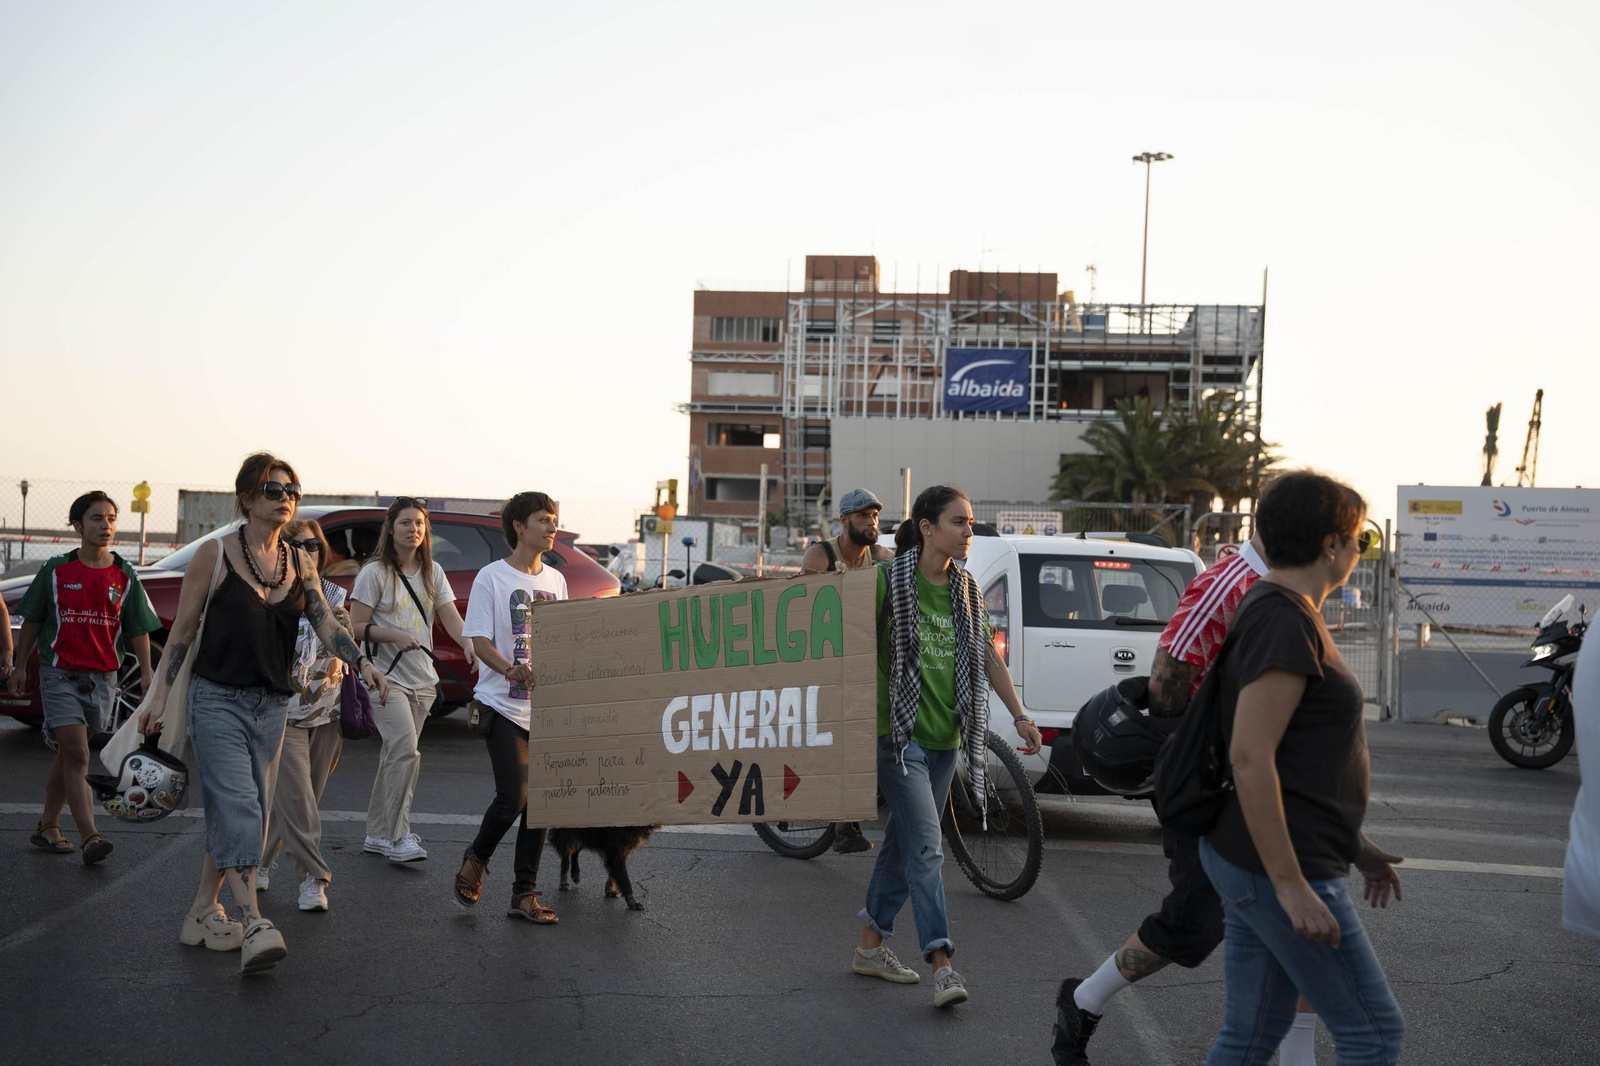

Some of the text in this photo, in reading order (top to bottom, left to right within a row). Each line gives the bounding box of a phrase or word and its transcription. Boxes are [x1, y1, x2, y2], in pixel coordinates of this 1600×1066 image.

[947, 379, 1024, 397] albaida
[1522, 505, 1547, 513] Puerto
[1548, 505, 1558, 513] de
[569, 623, 581, 642] de
[658, 583, 844, 671] HUELGA
[1117, 651, 1134, 659] KIA
[539, 659, 646, 686] Boicot internacional
[540, 706, 620, 736] Fin al genocidio
[661, 685, 834, 754] GENERAL
[543, 747, 646, 777] Reparación para el
[542, 777, 631, 810] pueblo palestino
[710, 759, 765, 817] YA
